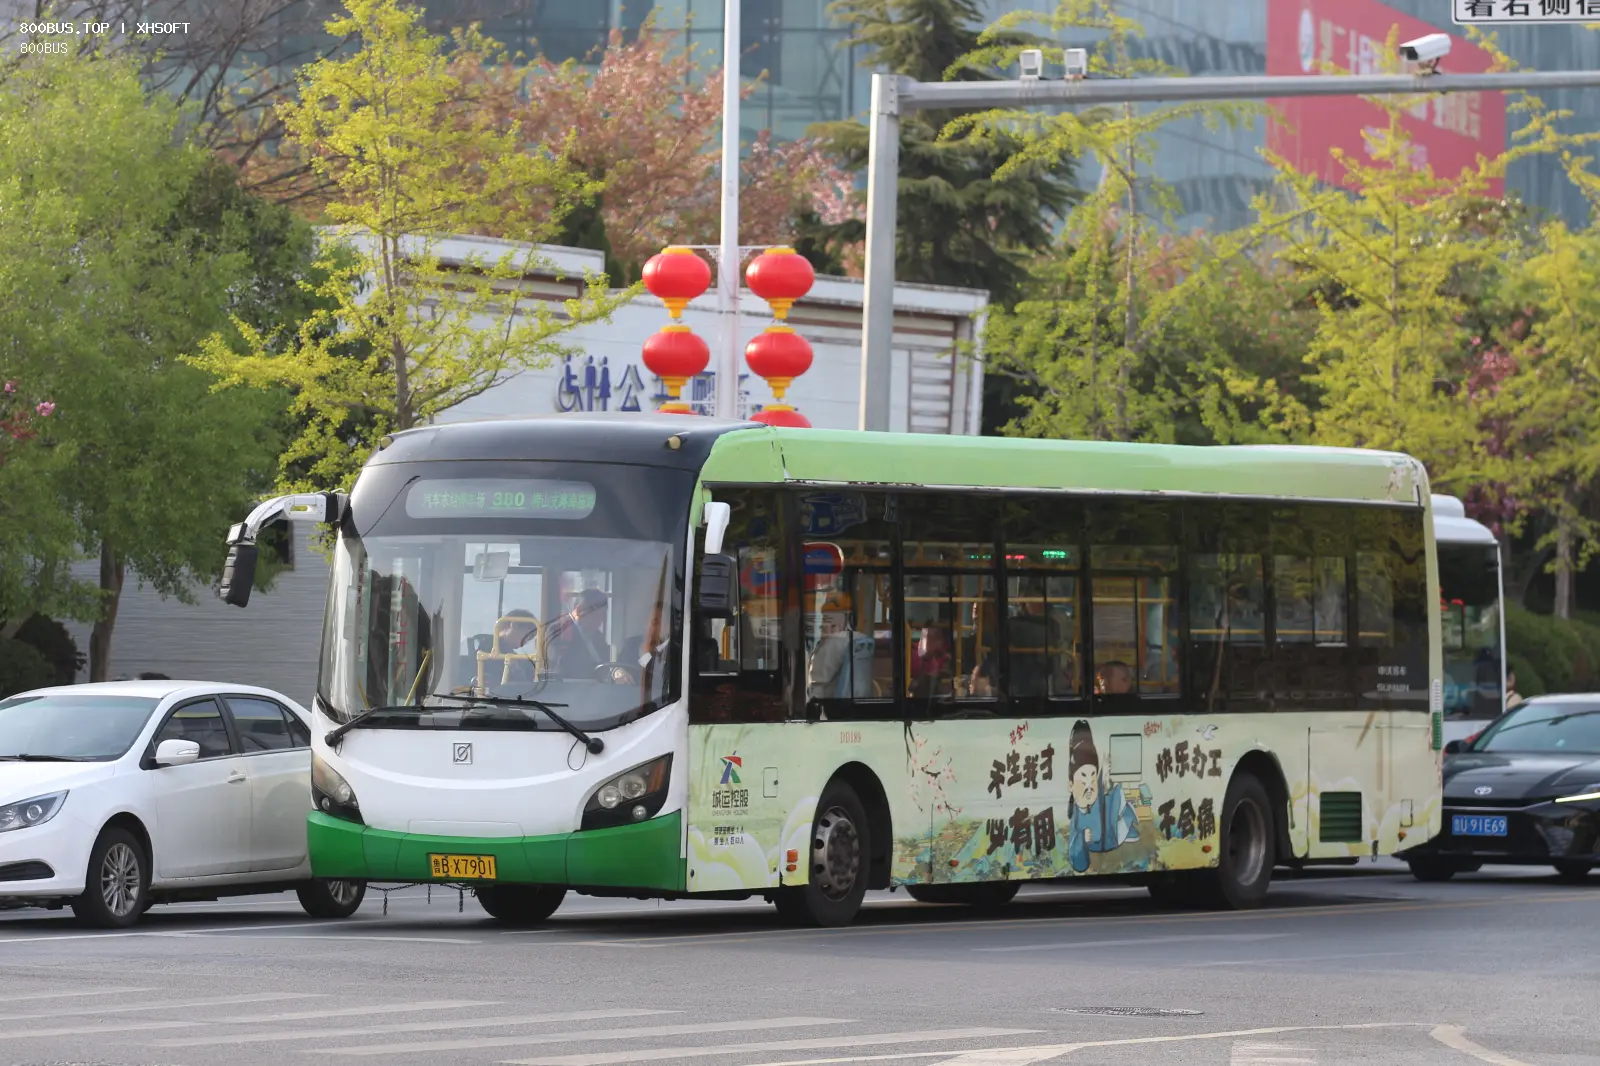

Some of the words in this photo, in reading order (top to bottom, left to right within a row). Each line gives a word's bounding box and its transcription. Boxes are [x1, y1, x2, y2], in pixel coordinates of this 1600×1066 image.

[1156, 740, 1222, 783] 快乐打工
[712, 789, 748, 808] 城运控股
[986, 806, 1056, 857] 必有用
